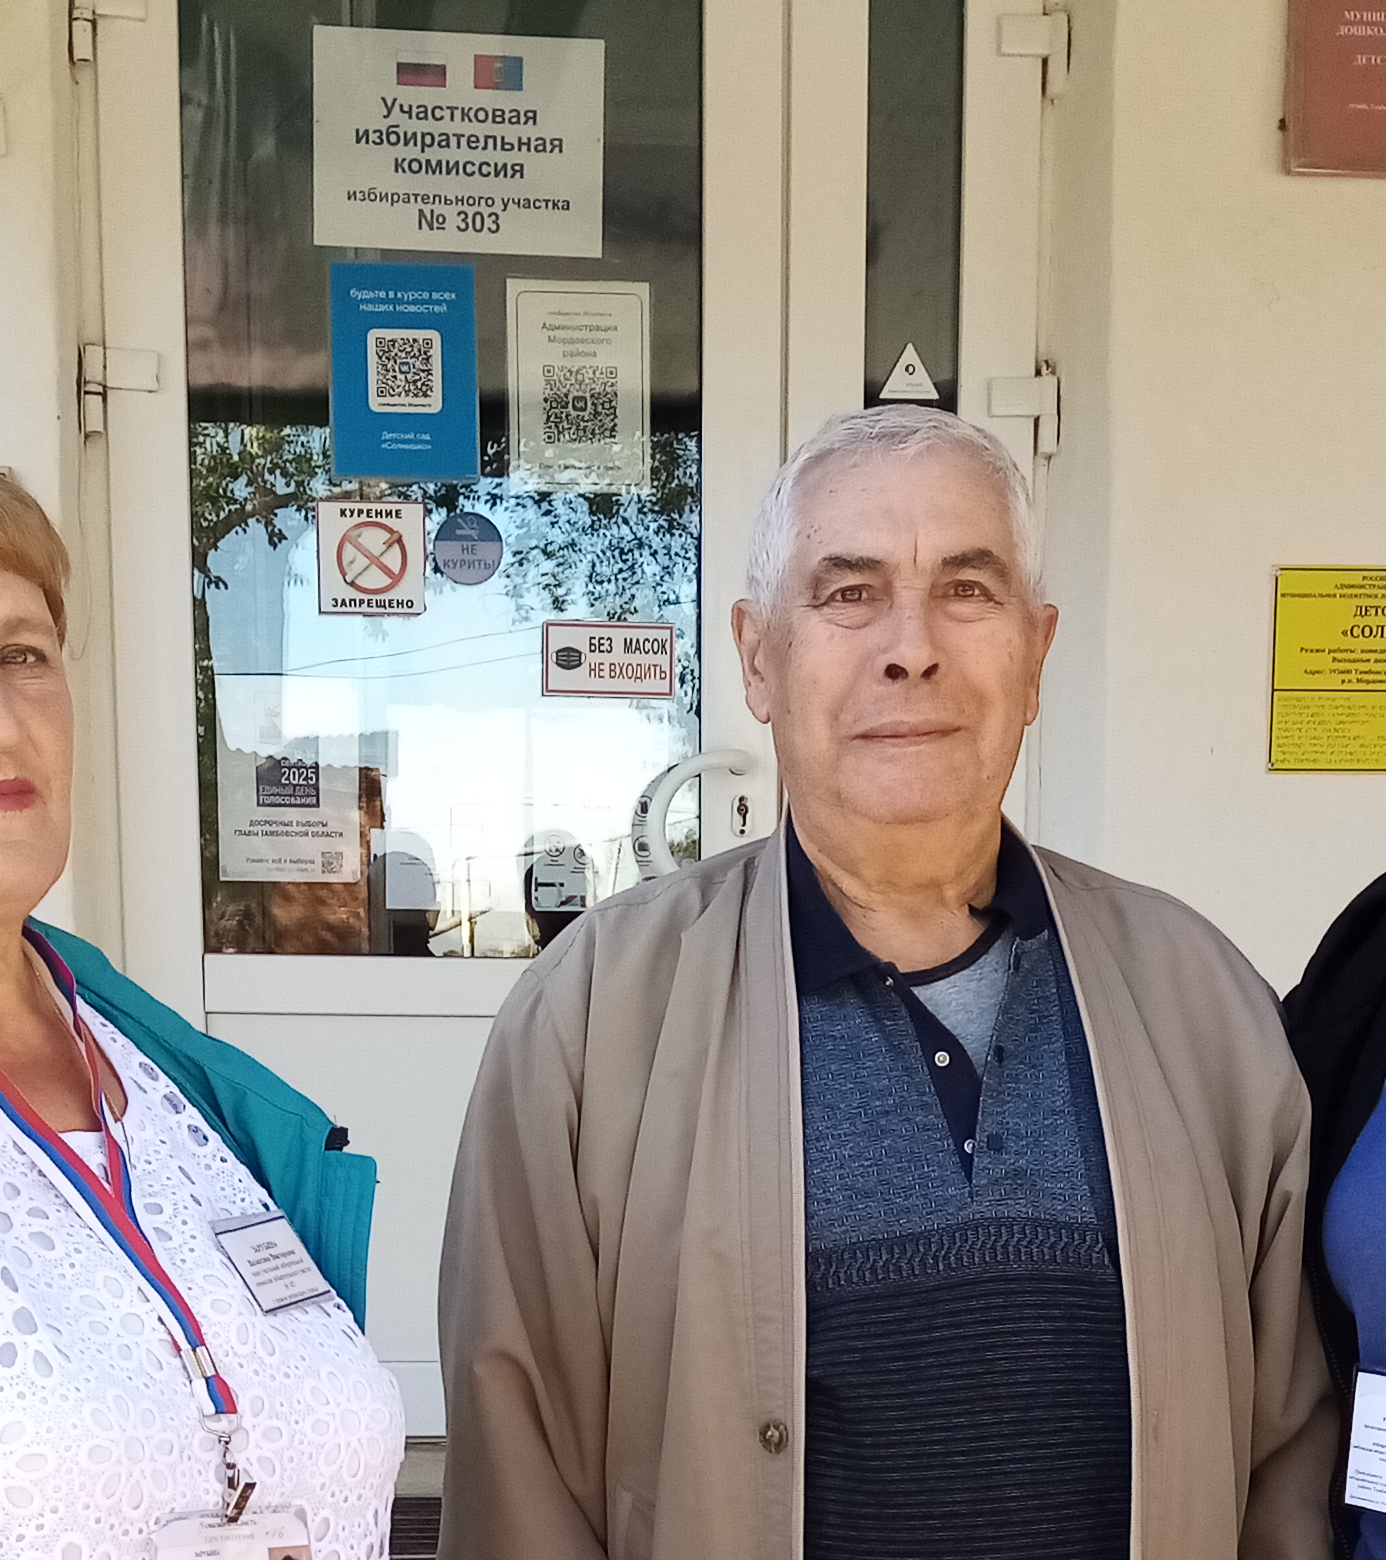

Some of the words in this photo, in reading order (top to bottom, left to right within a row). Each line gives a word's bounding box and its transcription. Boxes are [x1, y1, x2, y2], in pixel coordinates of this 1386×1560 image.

[380, 97, 539, 126] Участковая
[355, 125, 564, 154] избирательная
[393, 156, 525, 179] комиссия
[346, 188, 495, 208] избирательного
[501, 196, 571, 213] участка
[417, 209, 447, 231] №
[456, 211, 501, 234] 303
[349, 288, 387, 301] будьте
[388, 291, 396, 299] в
[397, 291, 430, 302] курсе
[431, 292, 458, 301] всех
[359, 302, 394, 312] наших
[395, 303, 448, 314] новостей
[541, 322, 618, 333] Администрация
[547, 335, 612, 346] Мордовского
[562, 347, 598, 359] района
[339, 507, 403, 520] КУРЕНИЕ
[460, 543, 478, 556] НЕ
[441, 557, 497, 571] КУРИТЬ!
[331, 597, 415, 610] ЗАПРЕЩЕНО
[588, 636, 613, 655] БЕЗ
[623, 636, 669, 656] МАСОК
[588, 661, 606, 680] НЕ
[608, 663, 668, 683] ВХОДИТЬ
[281, 767, 316, 785] 2025
[259, 784, 293, 795] ЕДИНЫЙ
[294, 785, 317, 796] ДЕНЬ
[249, 819, 293, 828] ДОСРОЧНЫЕ
[296, 820, 328, 828] ВЫБОРЫ
[261, 829, 309, 838] ТАМБОВСКОЙ
[311, 830, 344, 838] ОБЛАСТИ
